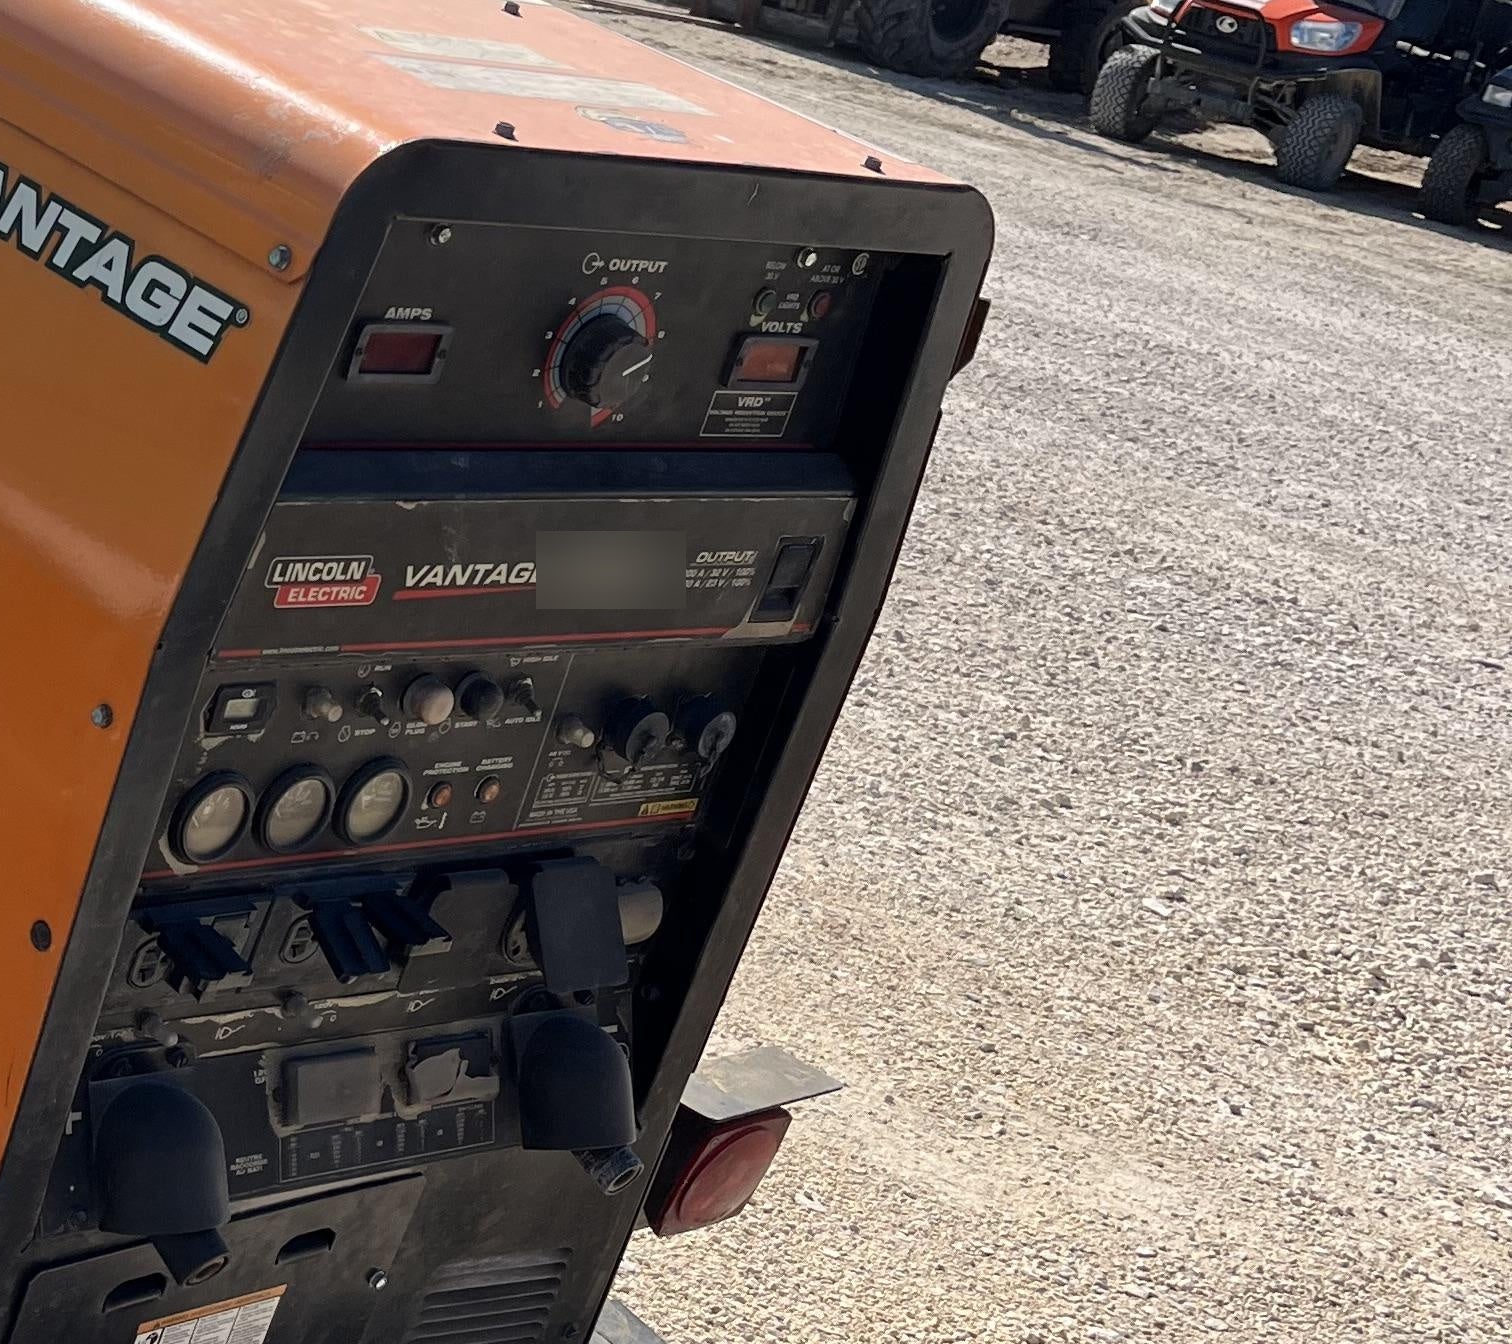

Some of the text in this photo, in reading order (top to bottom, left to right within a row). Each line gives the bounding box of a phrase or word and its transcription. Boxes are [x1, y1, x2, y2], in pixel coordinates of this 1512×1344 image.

[609, 258, 669, 274] OUTPUT
[568, 297, 576, 306] 4
[654, 292, 662, 301] 7
[385, 307, 433, 321] AMPS
[761, 322, 803, 334] VOLTS
[545, 330, 553, 339] 3
[737, 396, 764, 407] VRD
[611, 413, 624, 422] 10
[696, 550, 755, 563] OUTPUT
[272, 561, 366, 583] LINCOLN
[405, 562, 537, 587] VANTAG
[287, 585, 367, 603] ELECTRIC
[354, 728, 376, 737] STOP
